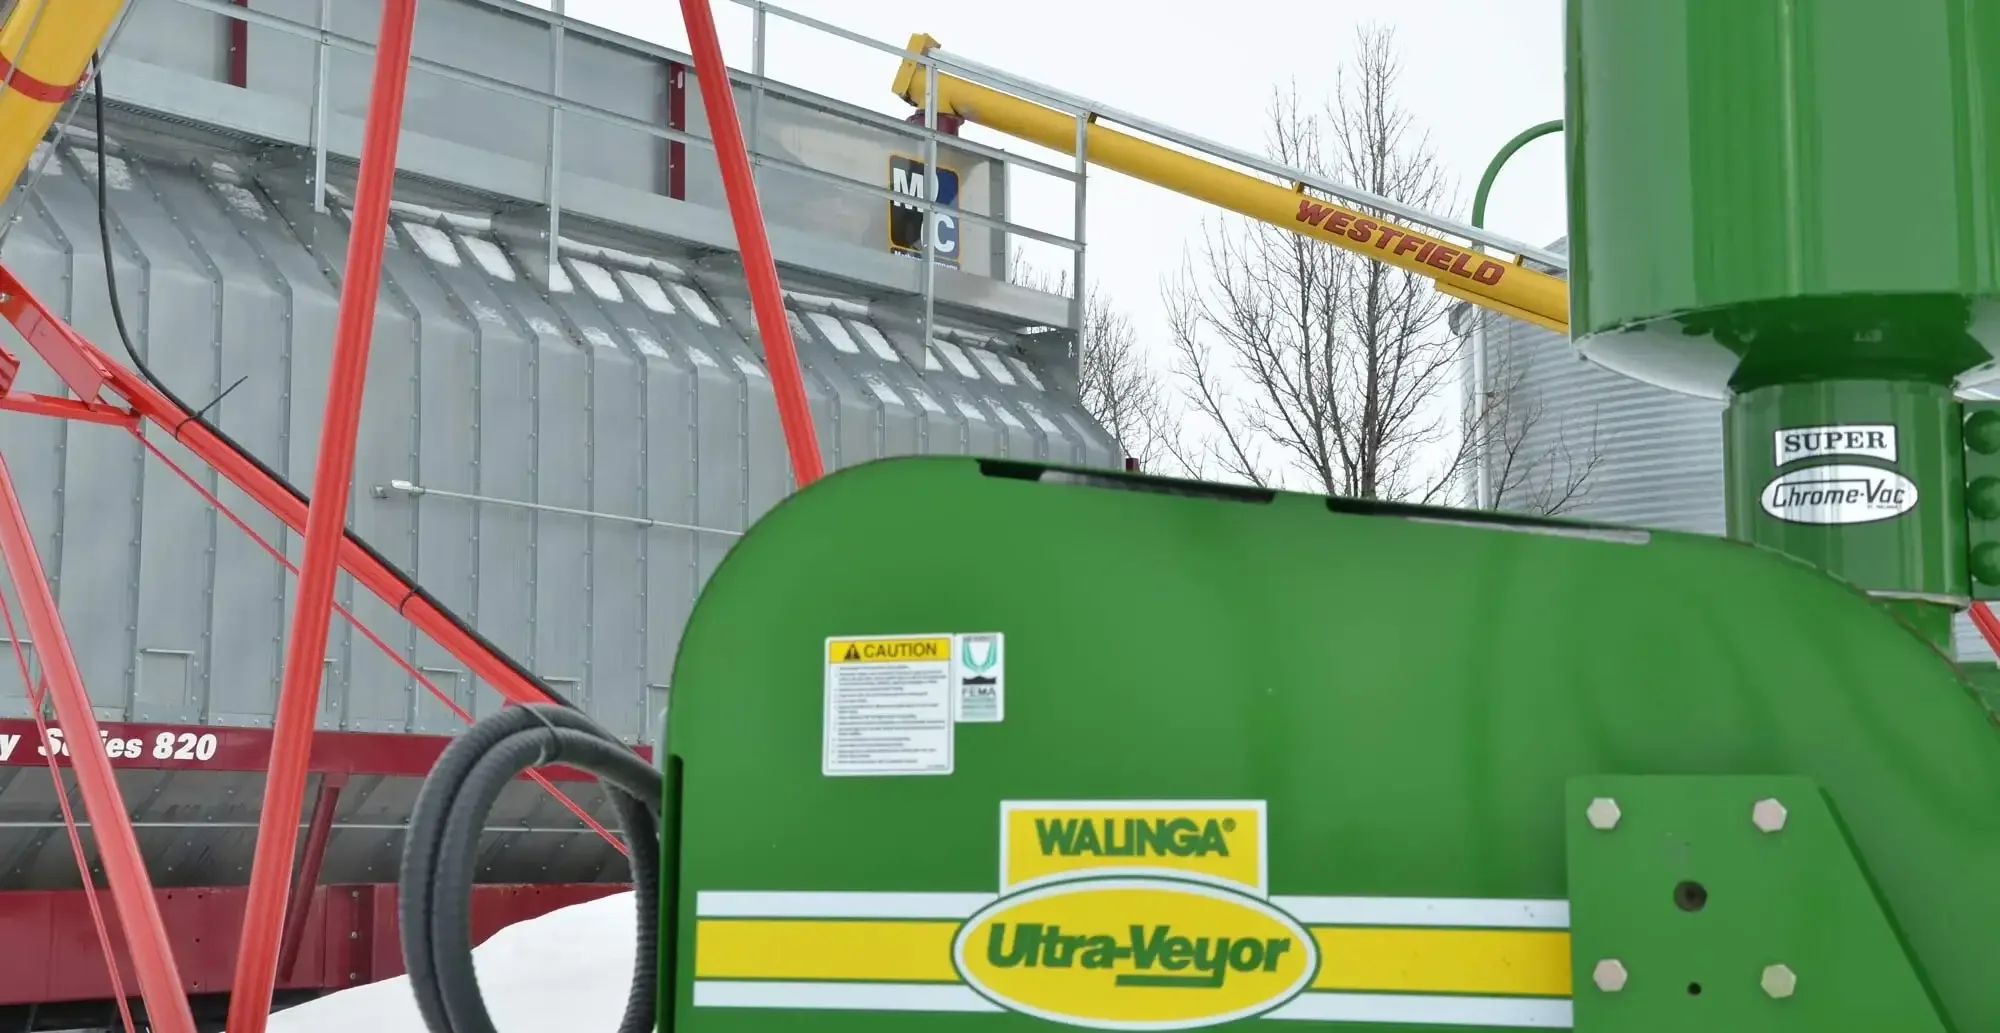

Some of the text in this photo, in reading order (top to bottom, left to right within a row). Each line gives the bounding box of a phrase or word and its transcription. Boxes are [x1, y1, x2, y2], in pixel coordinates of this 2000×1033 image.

[1296, 199, 1506, 287] WESTFIELD
[1784, 431, 1888, 453] SUPER
[1772, 478, 1906, 508] Chrome-Vac
[863, 642, 938, 659] CAUTION
[37, 727, 144, 759] Ses
[152, 731, 218, 762] 820
[986, 922, 1292, 989] Ultra-Veyor
